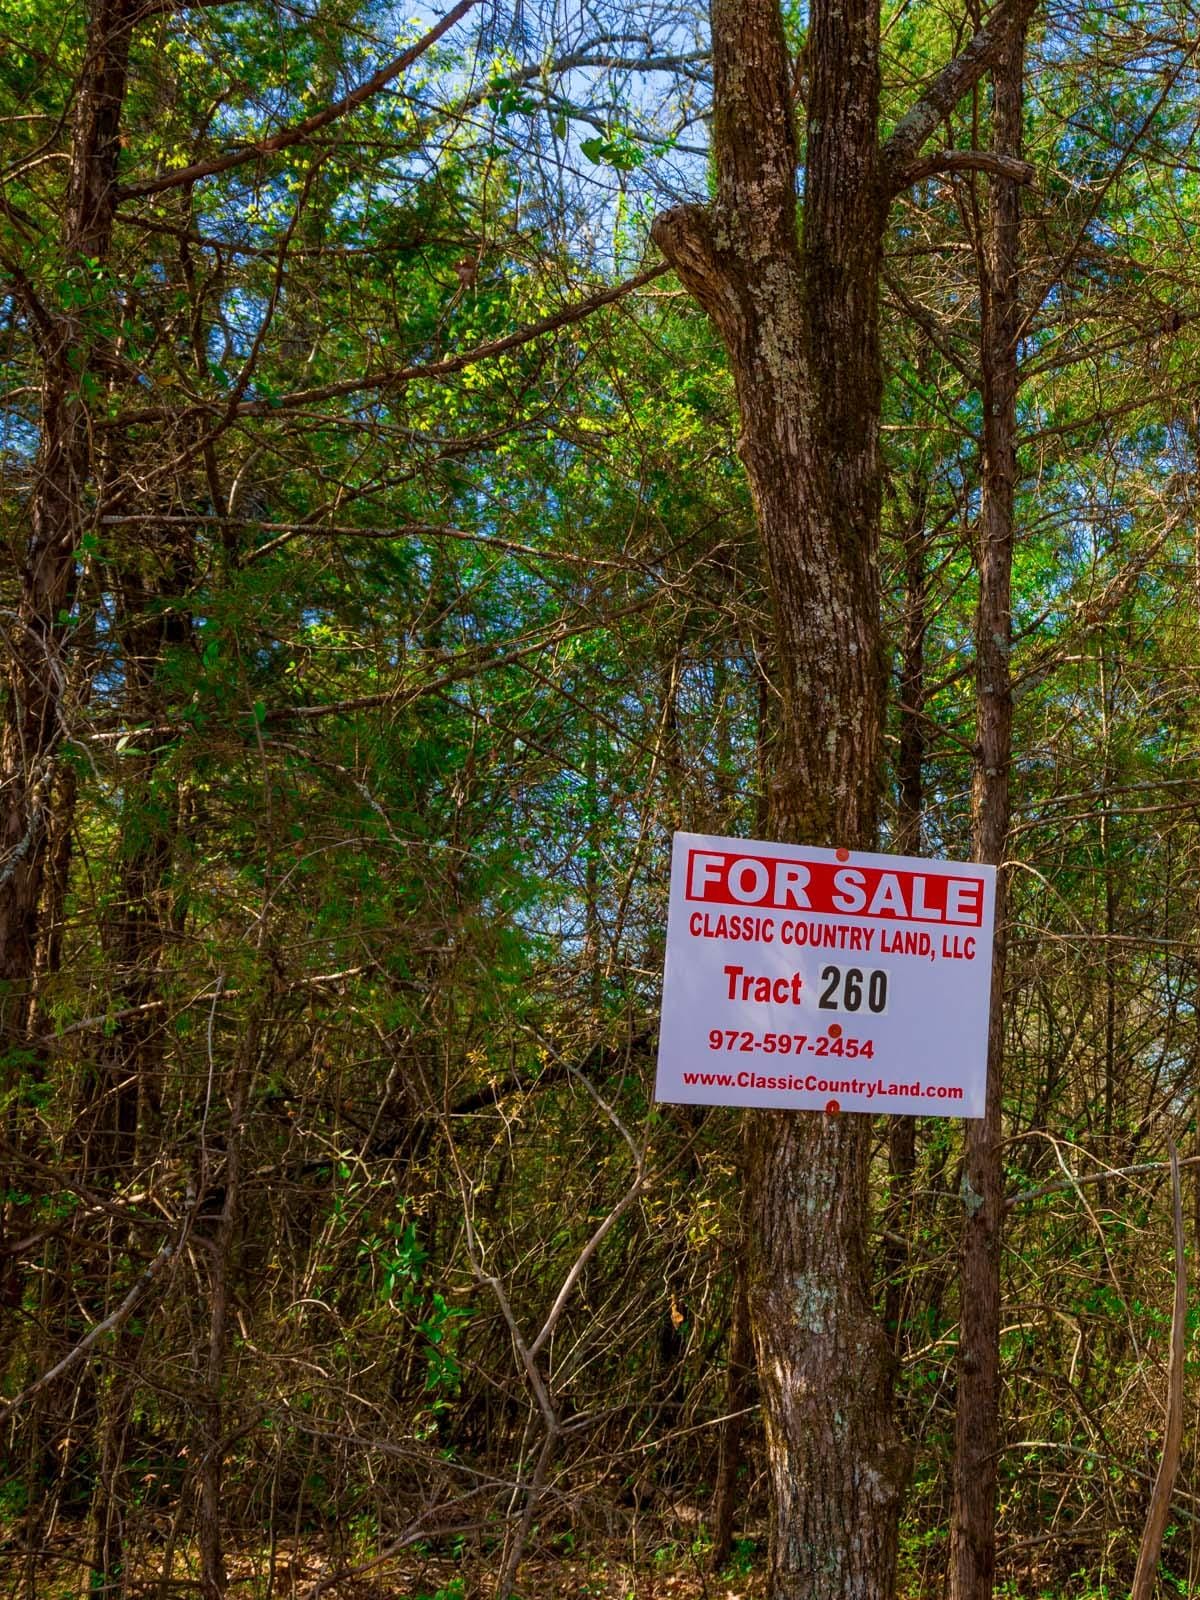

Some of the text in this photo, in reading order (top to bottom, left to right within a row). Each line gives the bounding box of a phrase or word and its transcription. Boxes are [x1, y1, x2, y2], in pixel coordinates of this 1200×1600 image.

[691, 854, 979, 923] FOR SALE
[689, 911, 976, 962] CLASSIC COUNTRY LAND, LLC
[724, 965, 888, 1013] Tract 260
[708, 1030, 874, 1059] 972-597-2454
[683, 1071, 963, 1099] www.ClassicCountryLand.com
